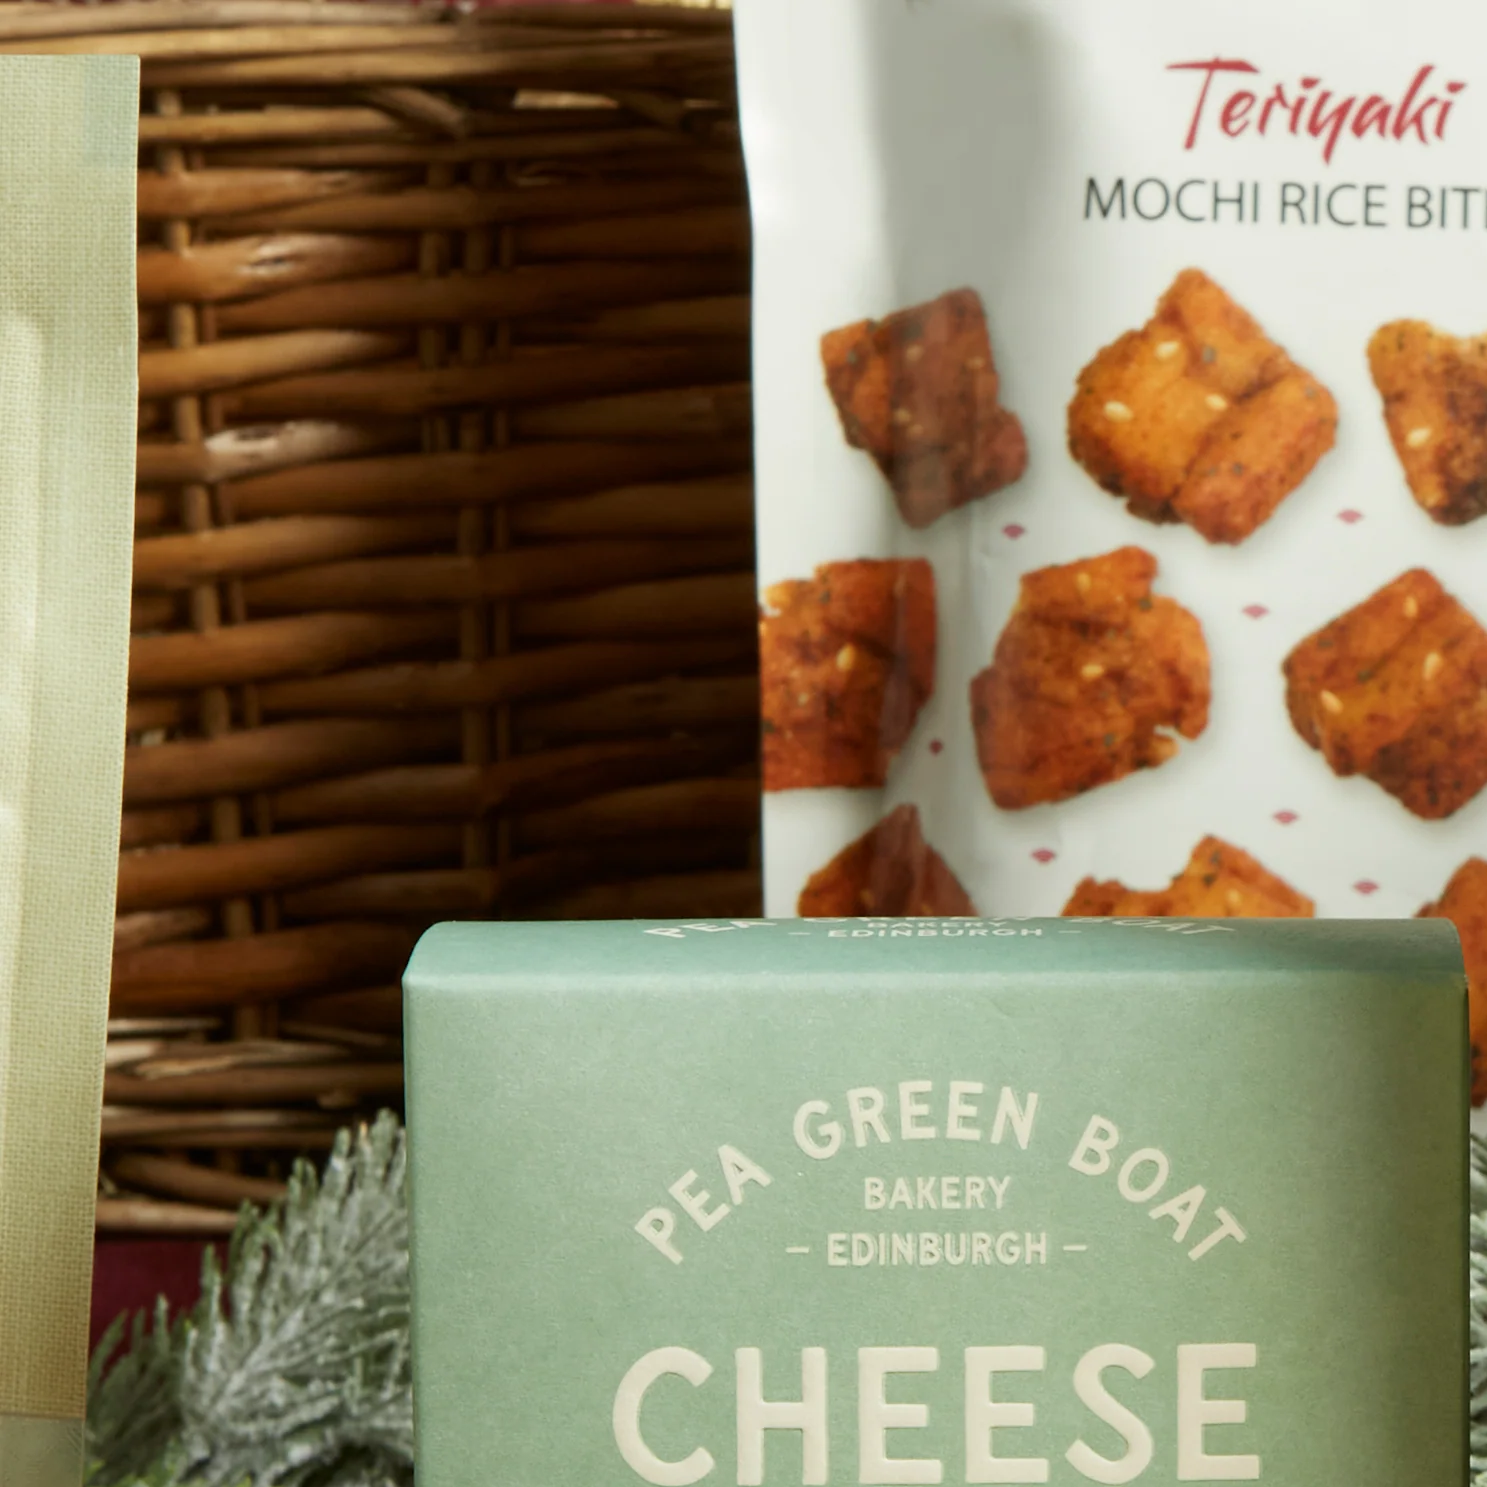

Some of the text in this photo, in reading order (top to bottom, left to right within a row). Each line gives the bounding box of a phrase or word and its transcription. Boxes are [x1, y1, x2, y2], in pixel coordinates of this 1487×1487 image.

[1165, 57, 1467, 165] Teriyaki
[1084, 177, 1259, 223] MOCHI
[1280, 181, 1389, 227] RICE
[827, 928, 1043, 938] EDINBURGH
[867, 921, 1008, 929] BAKERY
[634, 1080, 1247, 1266] PEA GREEN BOAT
[864, 1176, 1011, 1210] BAKERY
[826, 1232, 1047, 1267] EDINBURGH
[612, 1343, 1260, 1487] CHEESE
